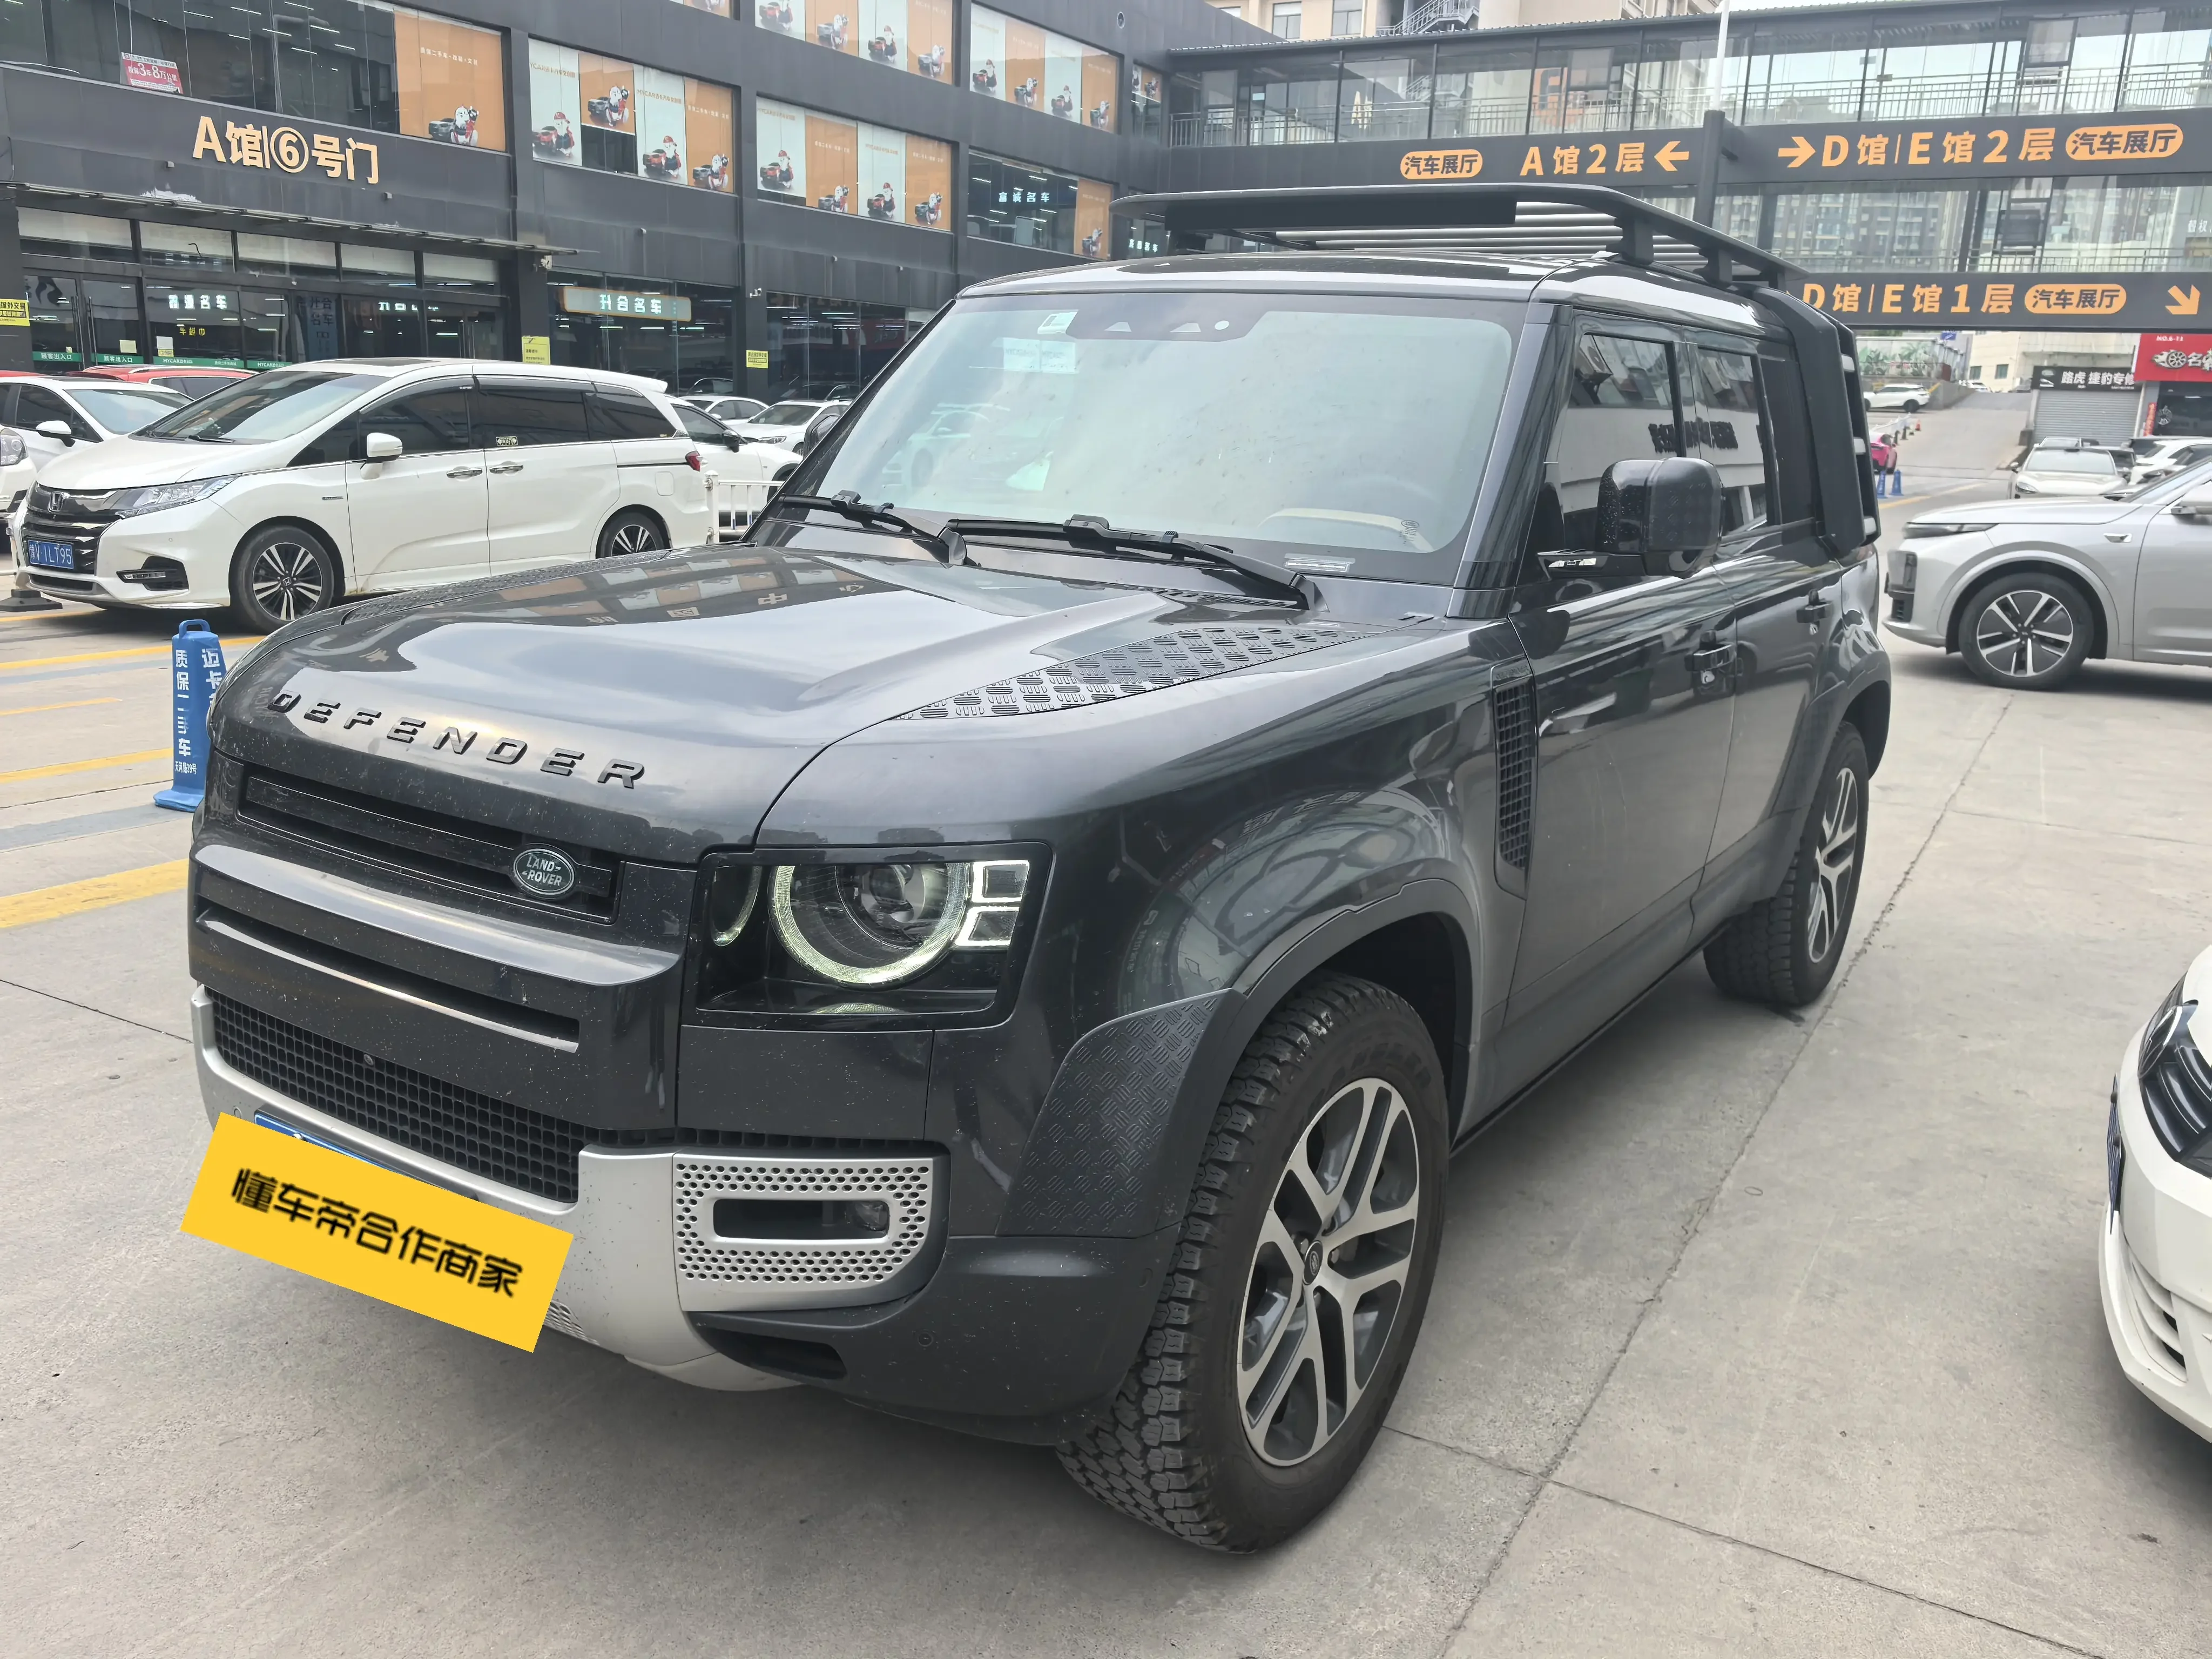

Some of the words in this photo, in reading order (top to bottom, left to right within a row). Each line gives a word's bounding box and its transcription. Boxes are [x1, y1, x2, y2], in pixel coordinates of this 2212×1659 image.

[2071, 129, 2179, 157] 汽车展厅
[1404, 153, 1478, 176] 汽车展厅
[2032, 288, 2121, 309] 汽车展厅
[2061, 371, 2086, 384] 路虎
[2088, 372, 2134, 385] 捷豹专修
[201, 648, 222, 703] 迈卡
[268, 690, 645, 789] DEFENDER
[175, 761, 197, 775] 天河路39号
[527, 855, 555, 872] LAND
[527, 869, 562, 887] ROVER
